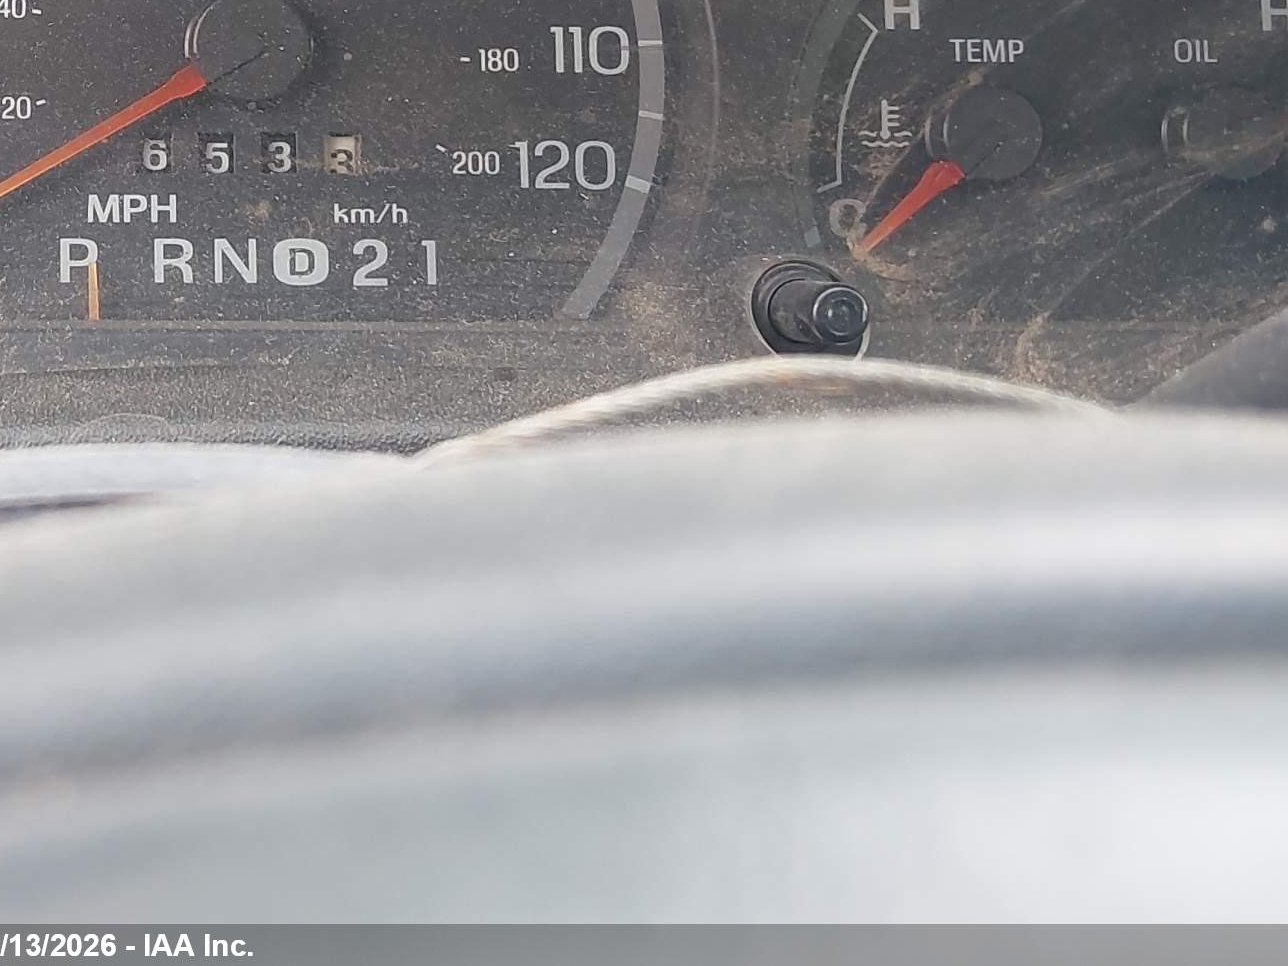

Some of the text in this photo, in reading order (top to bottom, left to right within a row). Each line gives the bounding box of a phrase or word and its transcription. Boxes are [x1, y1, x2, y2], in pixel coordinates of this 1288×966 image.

[479, 49, 519, 71] 180
[550, 26, 630, 74] 110
[949, 39, 1024, 62] TEMP
[1174, 39, 1217, 62] OIL
[1, 97, 31, 119] 20
[452, 151, 500, 174] 200
[514, 141, 615, 190] 120
[87, 194, 178, 223] MPH
[333, 203, 408, 224] km/h
[59, 238, 98, 283] P
[153, 238, 194, 283] R
[214, 238, 257, 284] N
[353, 239, 388, 286] 2
[422, 240, 437, 285] 1
